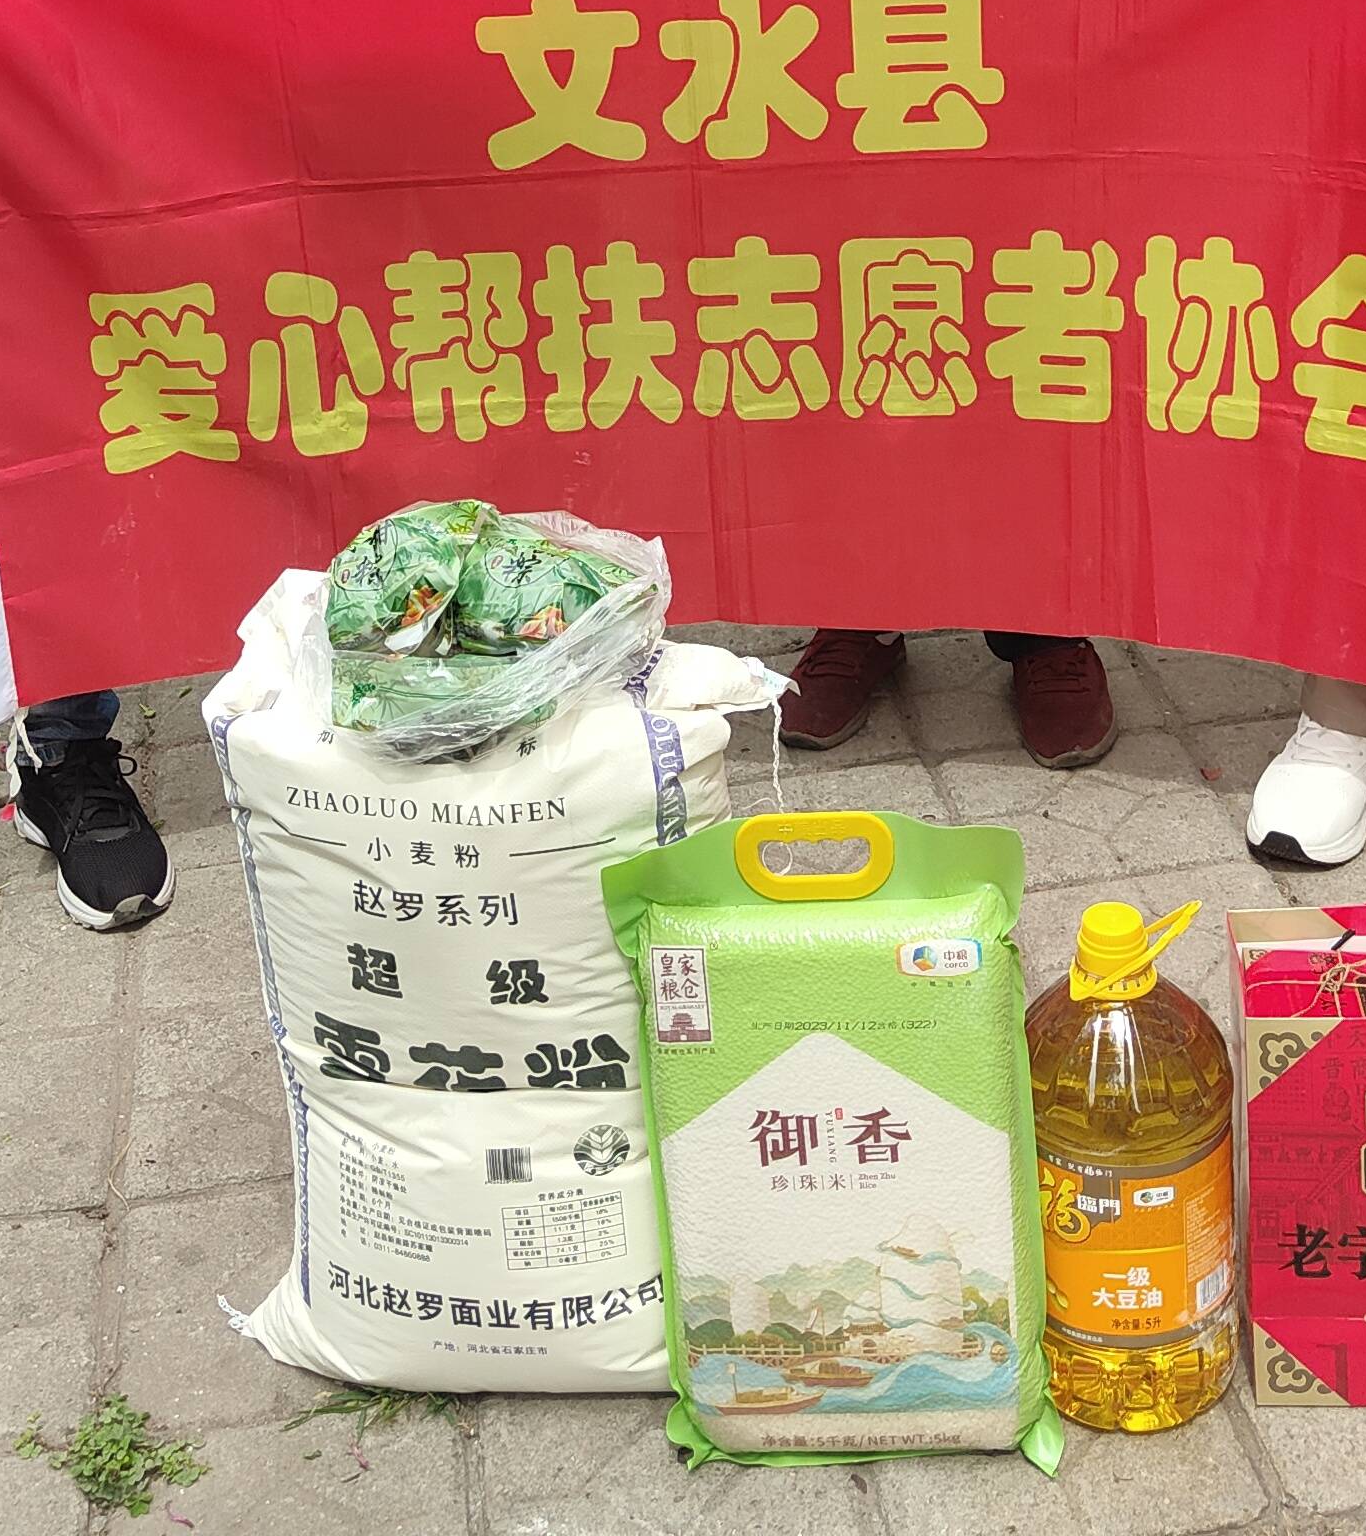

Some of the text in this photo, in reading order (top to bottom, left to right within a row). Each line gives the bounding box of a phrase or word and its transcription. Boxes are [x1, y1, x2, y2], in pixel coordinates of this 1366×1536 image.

[286, 786, 567, 826] ZHAOLUO MIANFEN
[367, 837, 481, 868] 小麦粉
[352, 879, 519, 927] 赵罗系列
[660, 953, 698, 977] 皇家
[944, 949, 968, 961] 中粮
[346, 942, 550, 1005] 超级
[660, 978, 699, 1001] 粮仓
[748, 1106, 912, 1167] 御香
[825, 1111, 838, 1164] YUXIANG
[770, 1173, 847, 1192] 珍珠米
[858, 1172, 897, 1181] Zhen Zhu
[537, 1188, 584, 1202] 营养成分表
[1102, 1266, 1150, 1287] 一级
[328, 1261, 664, 1331] 河北赵罗面业有限公司
[1092, 1287, 1164, 1310] 大豆油
[867, 1435, 897, 1446] NET
